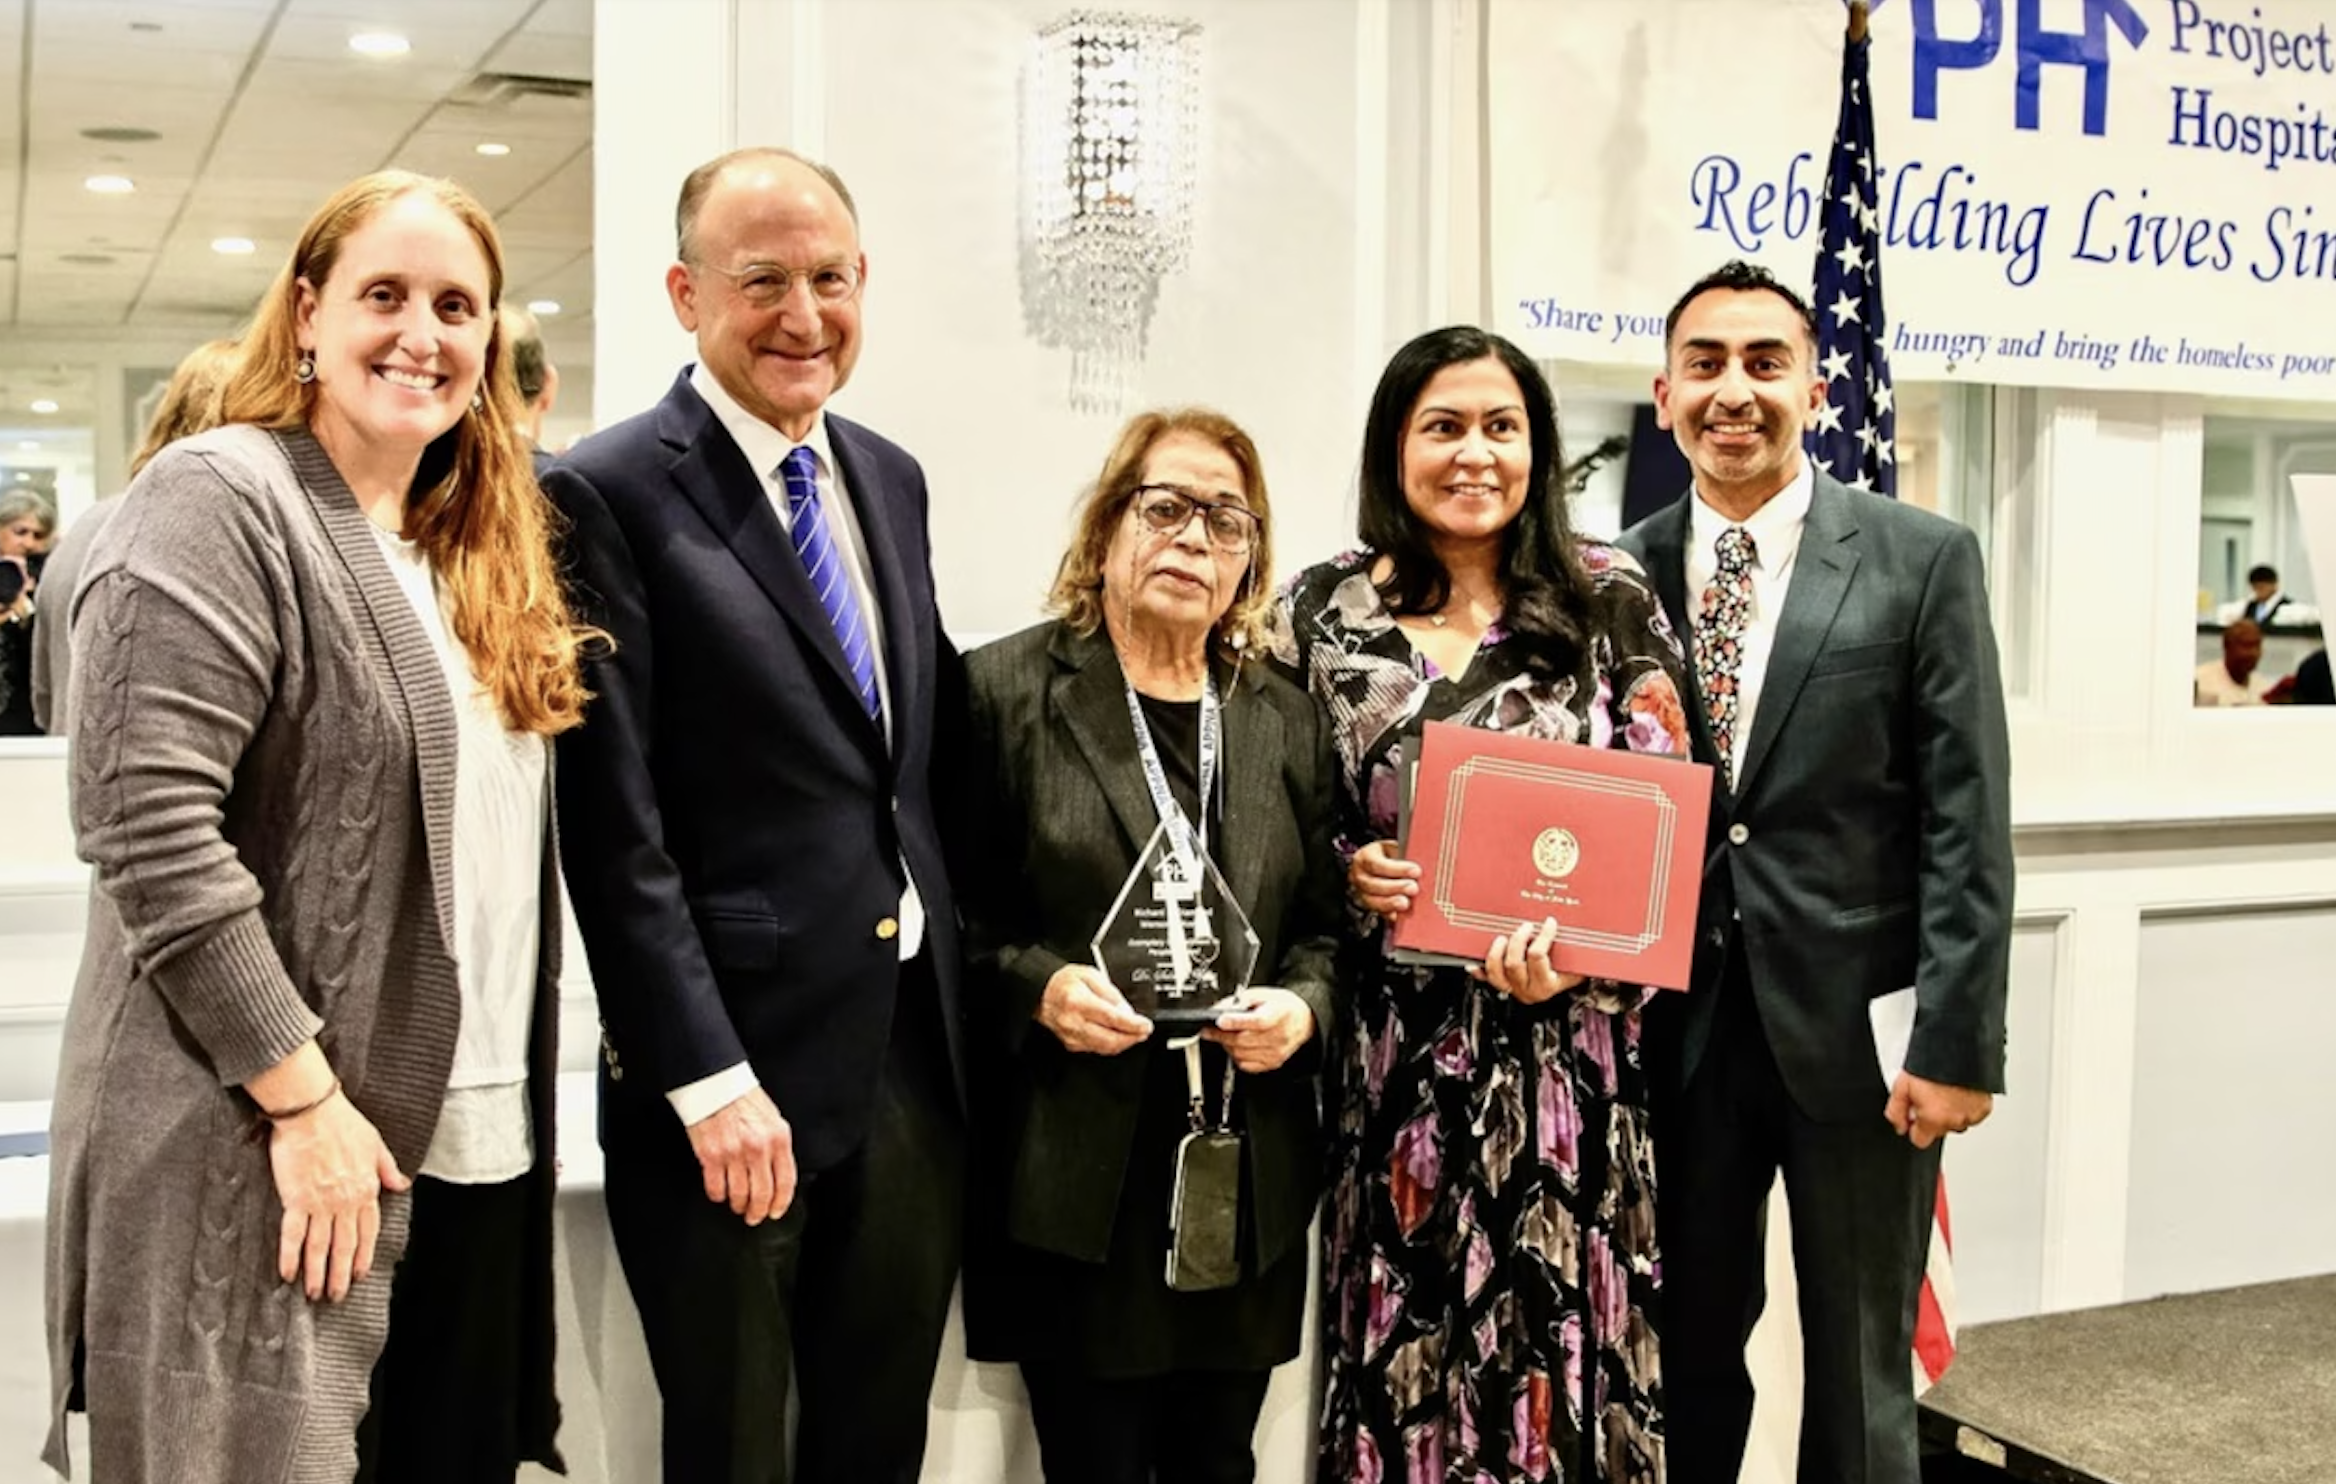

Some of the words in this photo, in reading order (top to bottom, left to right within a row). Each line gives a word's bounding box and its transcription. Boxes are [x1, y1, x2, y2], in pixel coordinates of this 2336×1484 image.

[1910, 0, 2109, 135] PH
[2169, 0, 2334, 77] Project
[1691, 152, 2049, 286] Reblding
[2071, 189, 2237, 271] Lives
[1893, 322, 1991, 363] hungry
[1997, 330, 2046, 358] and
[2054, 331, 2119, 370] bring
[2129, 335, 2169, 364] the
[2177, 338, 2275, 370] homeless
[2281, 354, 2336, 380] poor
